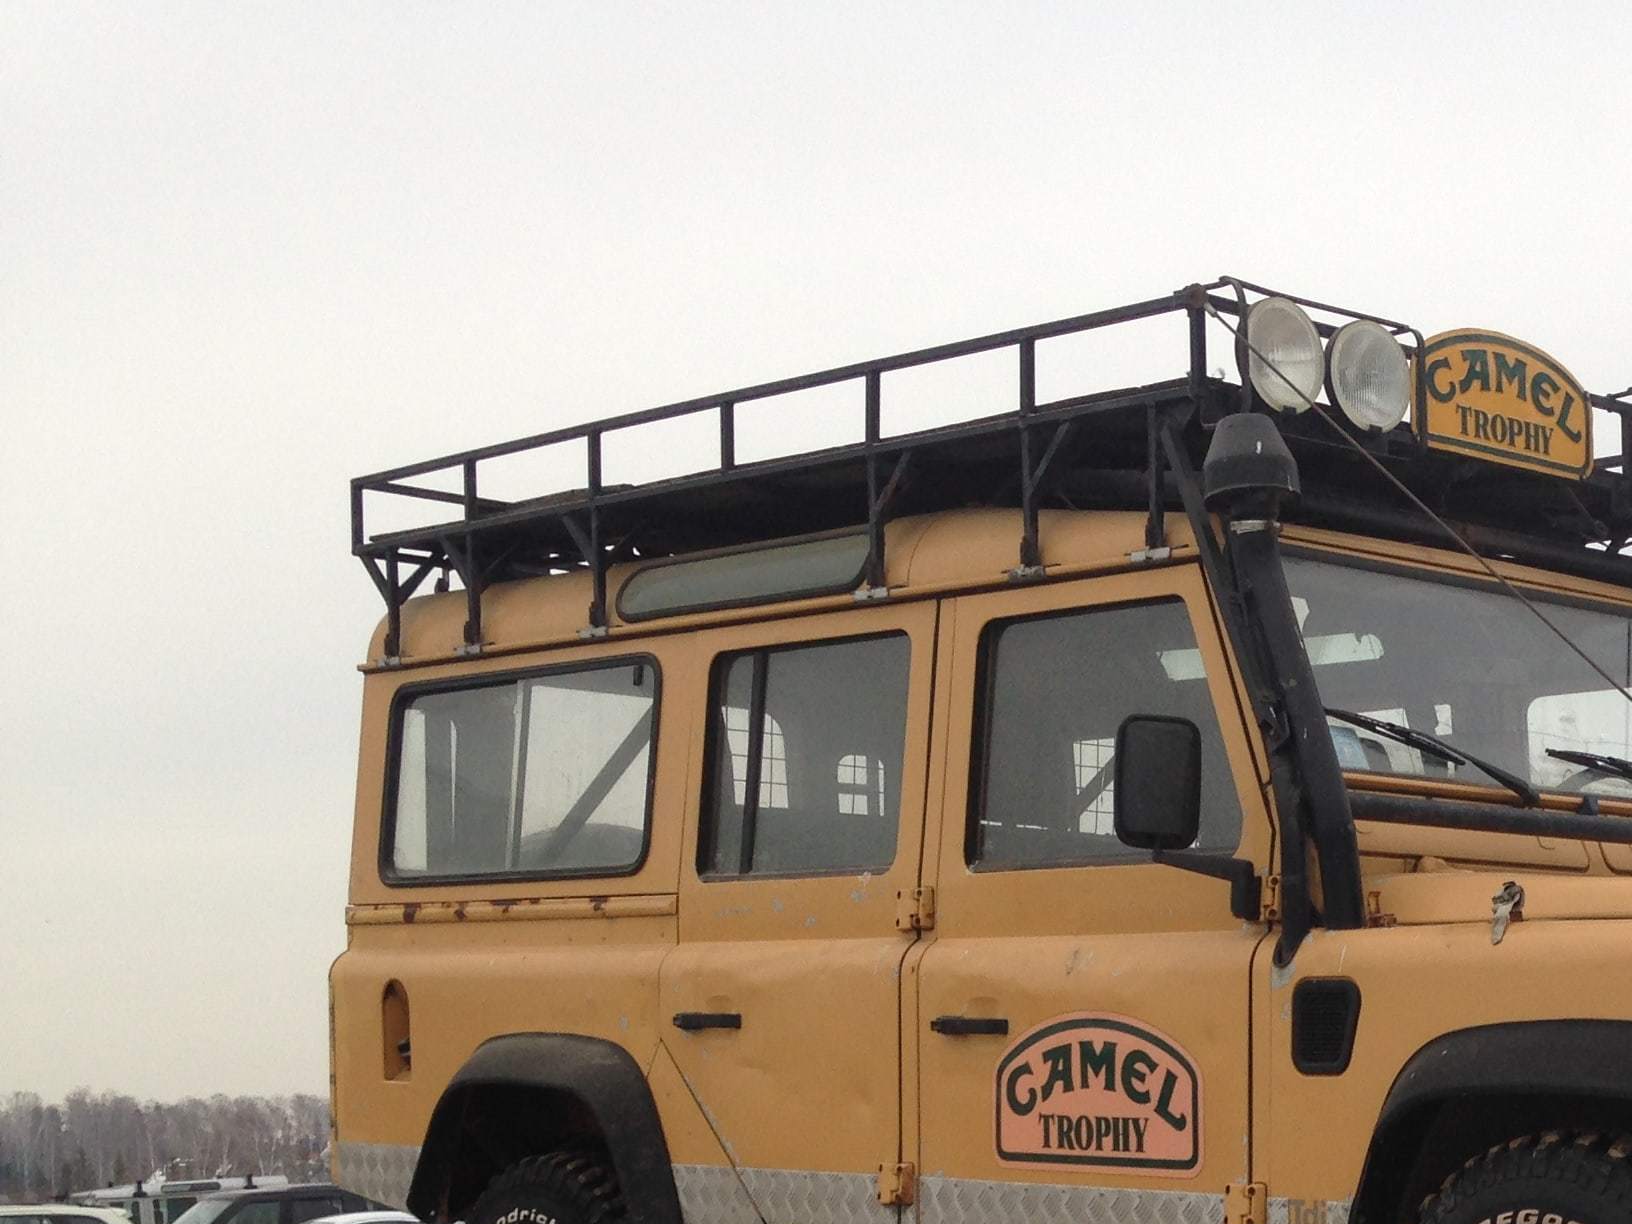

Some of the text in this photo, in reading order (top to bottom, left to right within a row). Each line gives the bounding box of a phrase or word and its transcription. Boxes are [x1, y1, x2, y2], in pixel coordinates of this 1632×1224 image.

[1424, 349, 1582, 444] CAMEL
[1455, 404, 1555, 455] TROPHY
[1006, 1040, 1187, 1132] CAMEL
[1038, 1112, 1149, 1153] TROPHY
